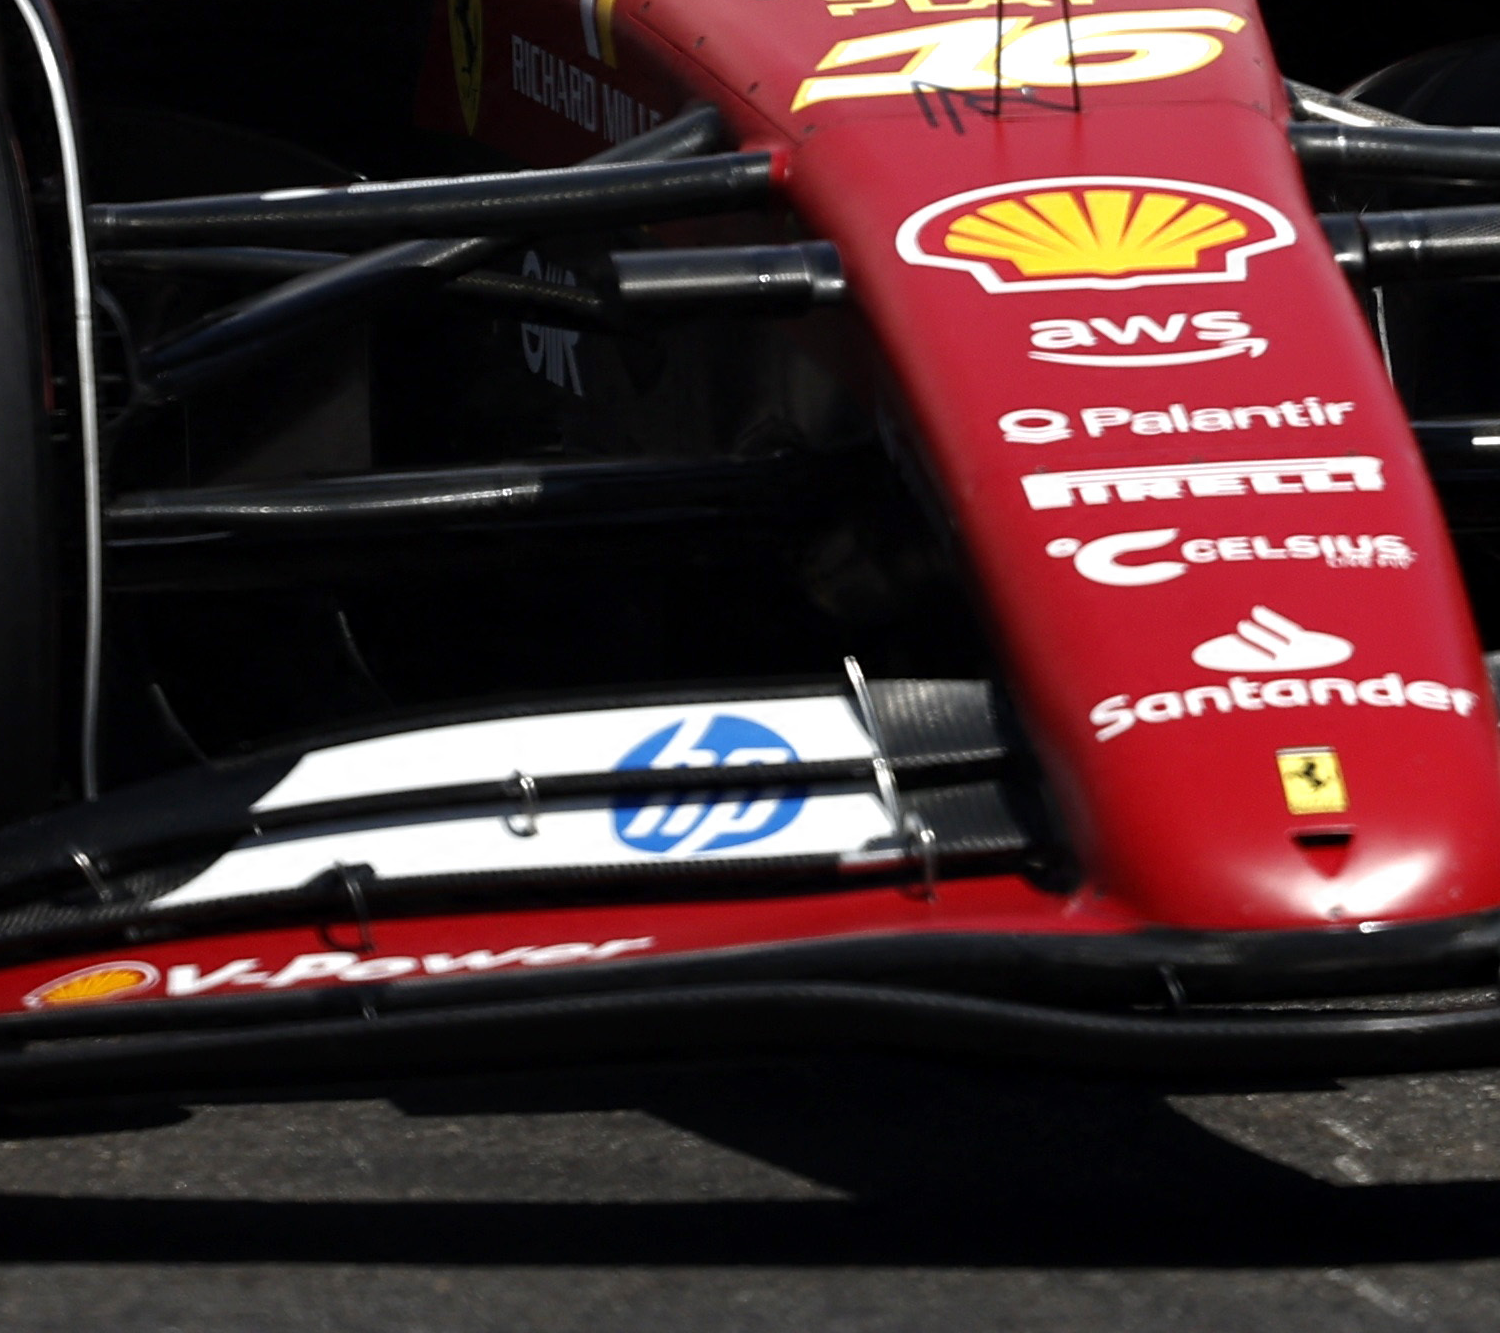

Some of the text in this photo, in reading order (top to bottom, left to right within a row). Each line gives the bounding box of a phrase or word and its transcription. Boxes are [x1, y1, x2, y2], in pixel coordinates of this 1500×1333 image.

[511, 33, 598, 133] RICHARD
[790, 8, 1246, 113] 16
[1029, 309, 1252, 350] aws
[1082, 398, 1355, 439] Palantir
[1021, 456, 1385, 510] PIRELLI
[1181, 534, 1412, 564] CELSIUS
[1089, 674, 1480, 742] Santander
[162, 934, 657, 998] V-Power
